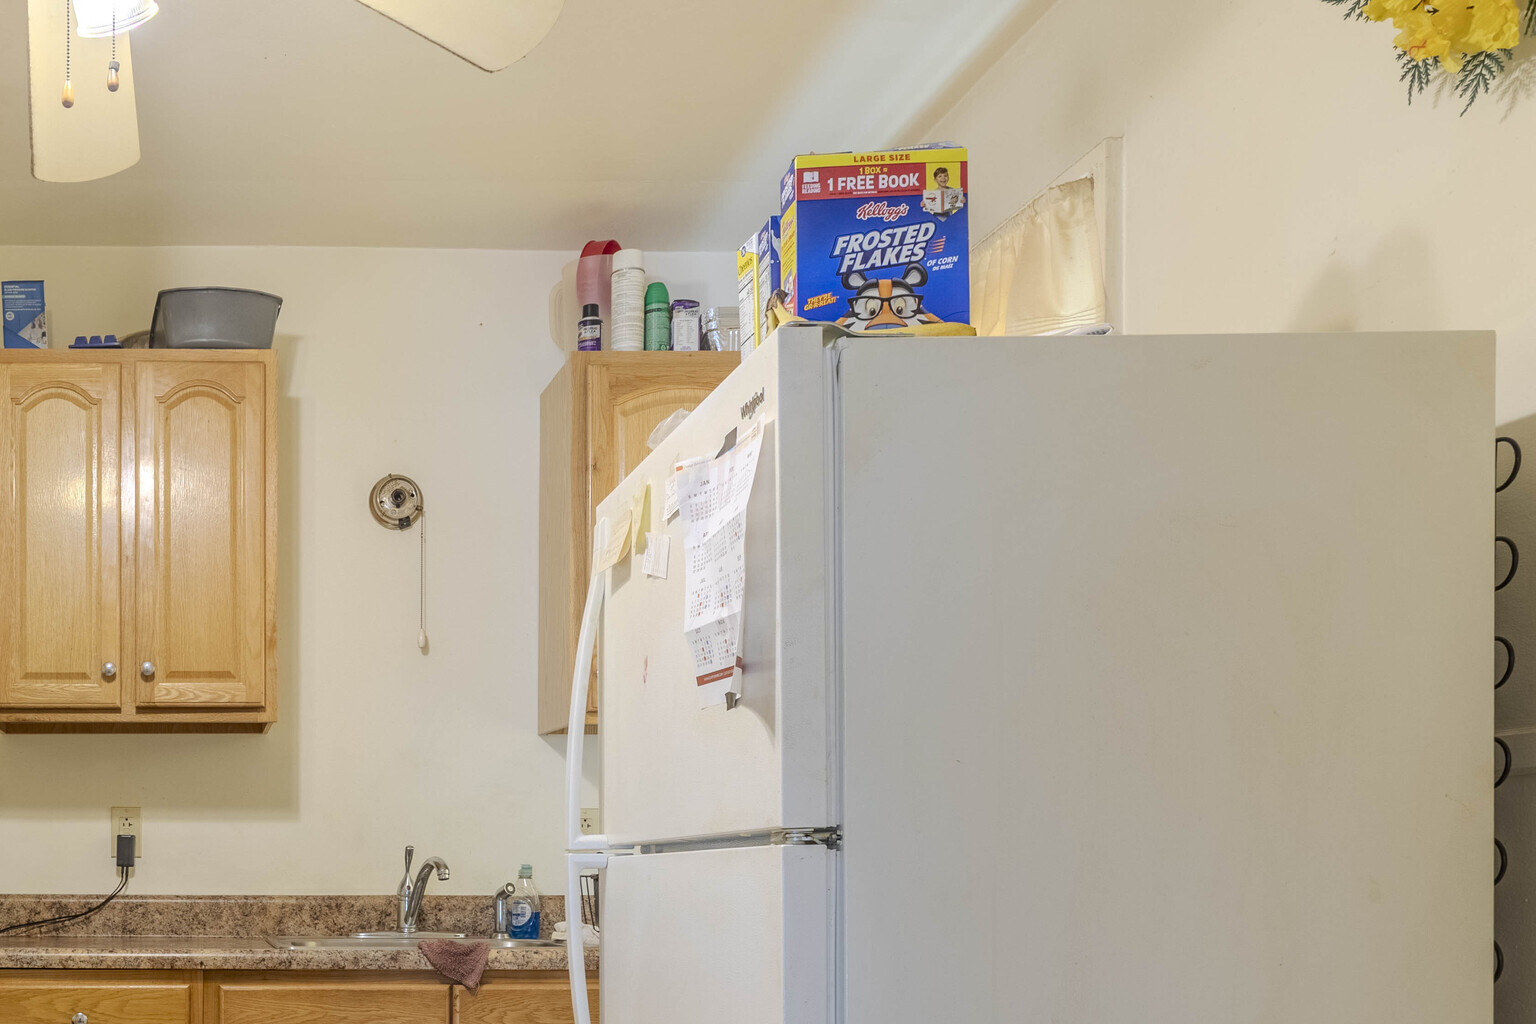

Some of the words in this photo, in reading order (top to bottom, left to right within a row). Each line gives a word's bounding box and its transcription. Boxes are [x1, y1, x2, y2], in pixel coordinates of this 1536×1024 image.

[853, 154, 886, 163] LARGE
[889, 153, 911, 161] SIZE
[859, 167, 863, 175] 1
[864, 166, 882, 175] BOX
[827, 177, 834, 191] 1
[837, 175, 875, 191] FREE
[878, 172, 920, 189] BOOK
[856, 201, 909, 222] Kellogg's
[832, 221, 936, 257] FROSTED
[839, 242, 924, 274] FLAKES
[926, 259, 937, 267] OF
[937, 256, 959, 265] CORN
